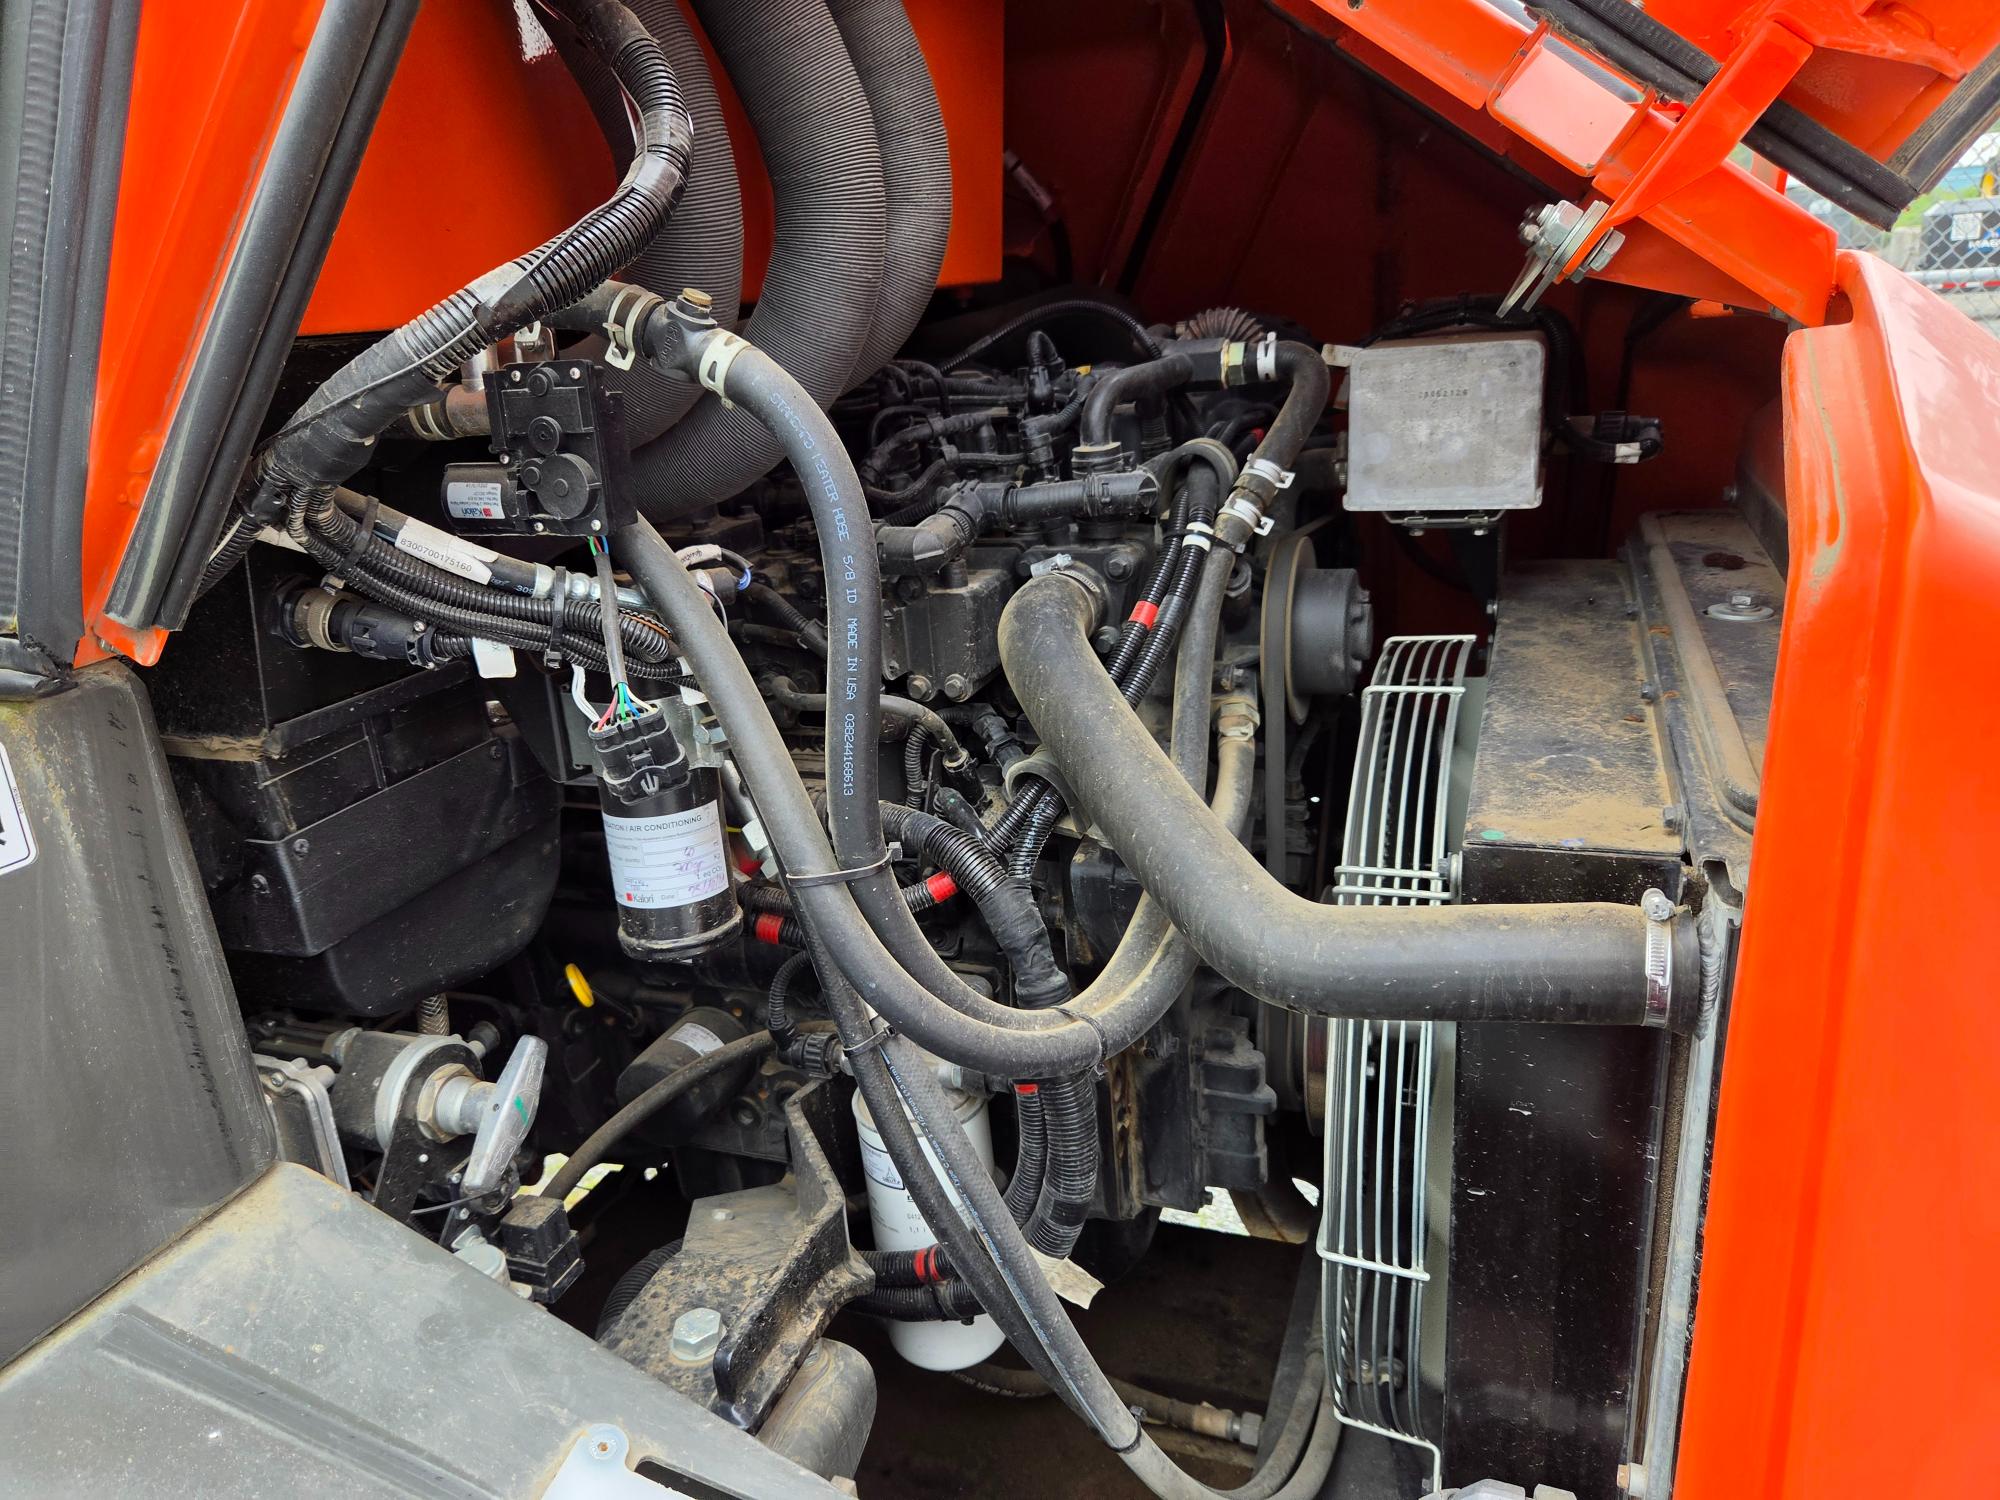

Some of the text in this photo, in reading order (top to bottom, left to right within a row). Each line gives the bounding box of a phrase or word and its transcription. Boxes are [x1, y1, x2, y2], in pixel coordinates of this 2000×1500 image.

[832, 507, 850, 543] HOSE
[399, 538, 473, 573] 8300700175160
[842, 555, 855, 580] 5/8
[846, 588, 858, 604] ID
[847, 617, 858, 649] MADE
[847, 657, 858, 672] IN
[846, 677, 857, 700] USA
[842, 713, 856, 796] 038244168613
[644, 814, 702, 832] CONDITIONING
